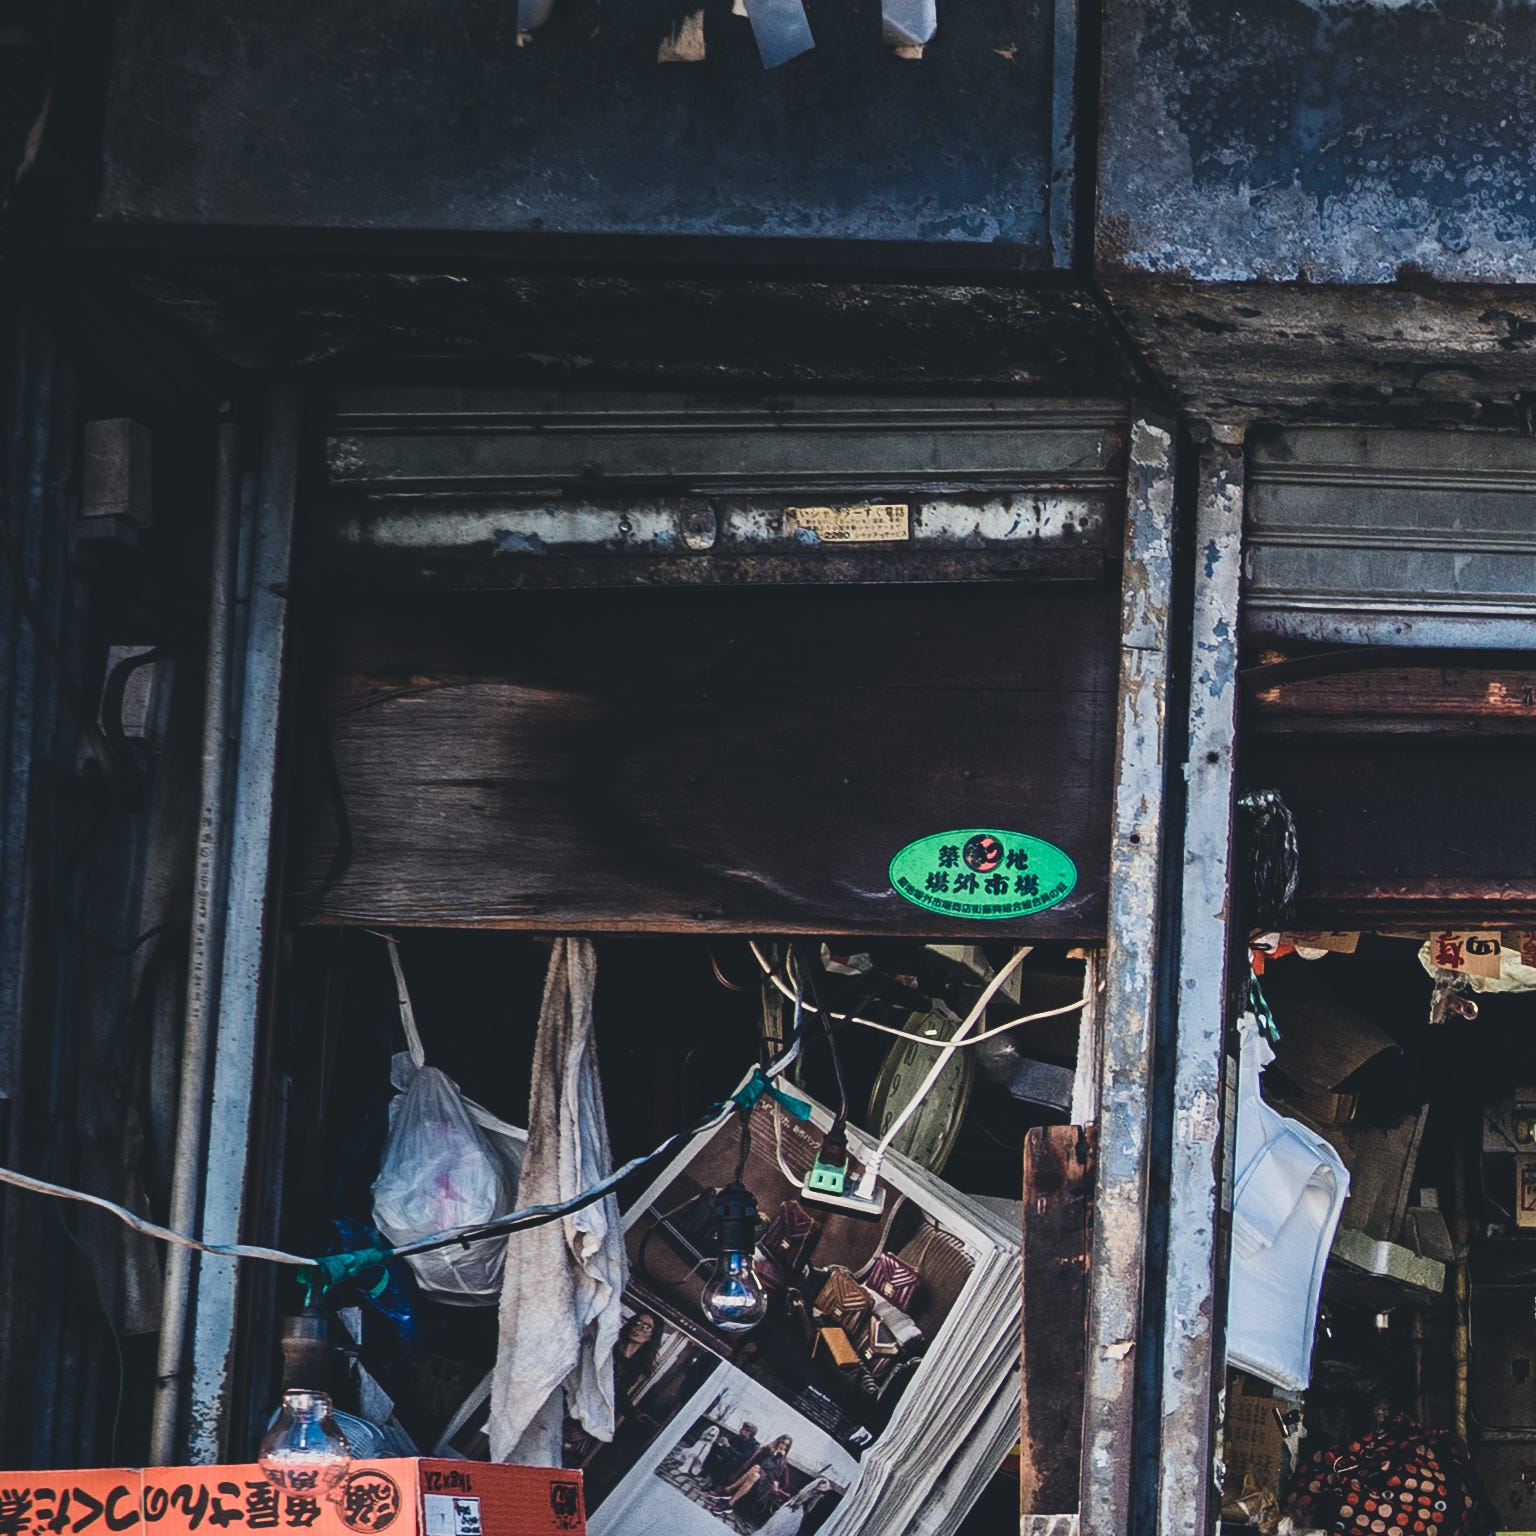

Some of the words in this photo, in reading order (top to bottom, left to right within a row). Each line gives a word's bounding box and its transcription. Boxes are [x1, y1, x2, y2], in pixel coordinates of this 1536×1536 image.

[939, 846, 1029, 870] 築地
[925, 871, 1040, 896] 場外市場
